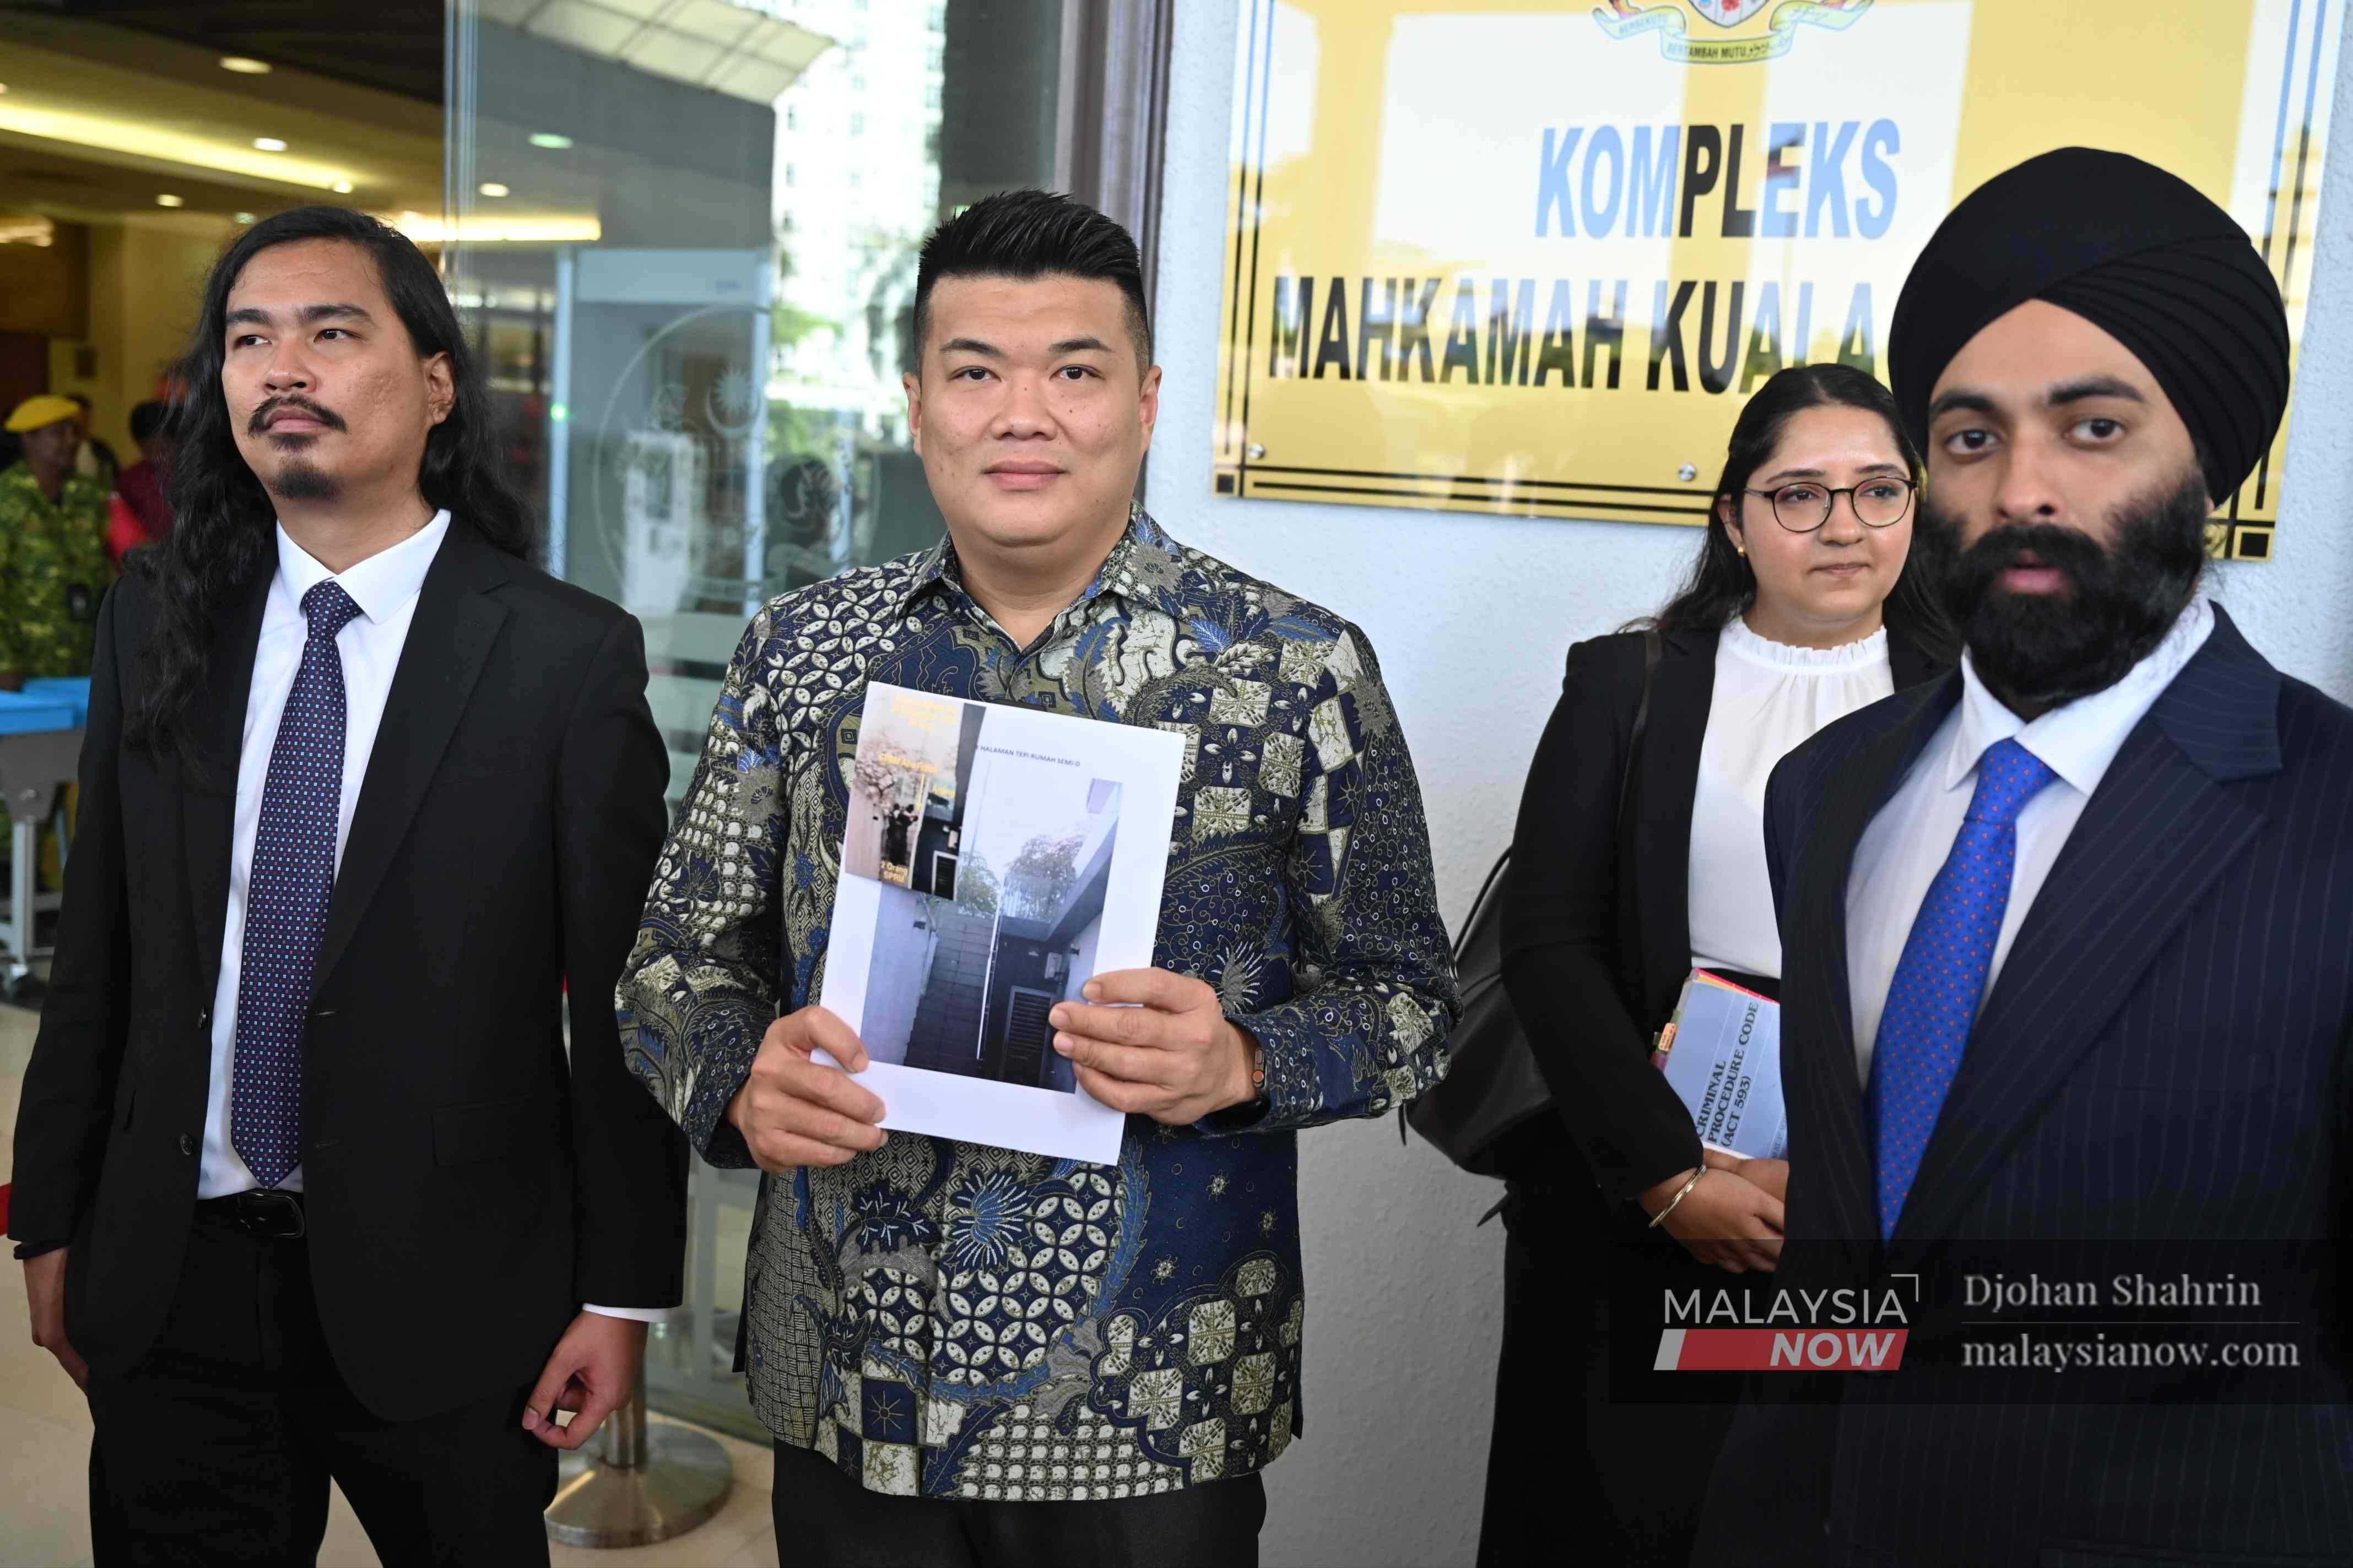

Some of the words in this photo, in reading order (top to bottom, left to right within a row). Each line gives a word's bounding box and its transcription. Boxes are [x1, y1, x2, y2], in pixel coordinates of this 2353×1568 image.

[1535, 118, 1901, 240] KOMPLEKS
[1268, 275, 1627, 390] MAHKAMAH
[980, 745, 1014, 756] HALAMAN
[1031, 753, 1056, 763] RUMAH
[1696, 1060, 1727, 1137] CRIMINAL
[1707, 1048, 1745, 1143] PROCEDURE
[1738, 1001, 1759, 1046] CODE
[1721, 1111, 1740, 1147] (ACT
[1735, 1075, 1751, 1109] 593)
